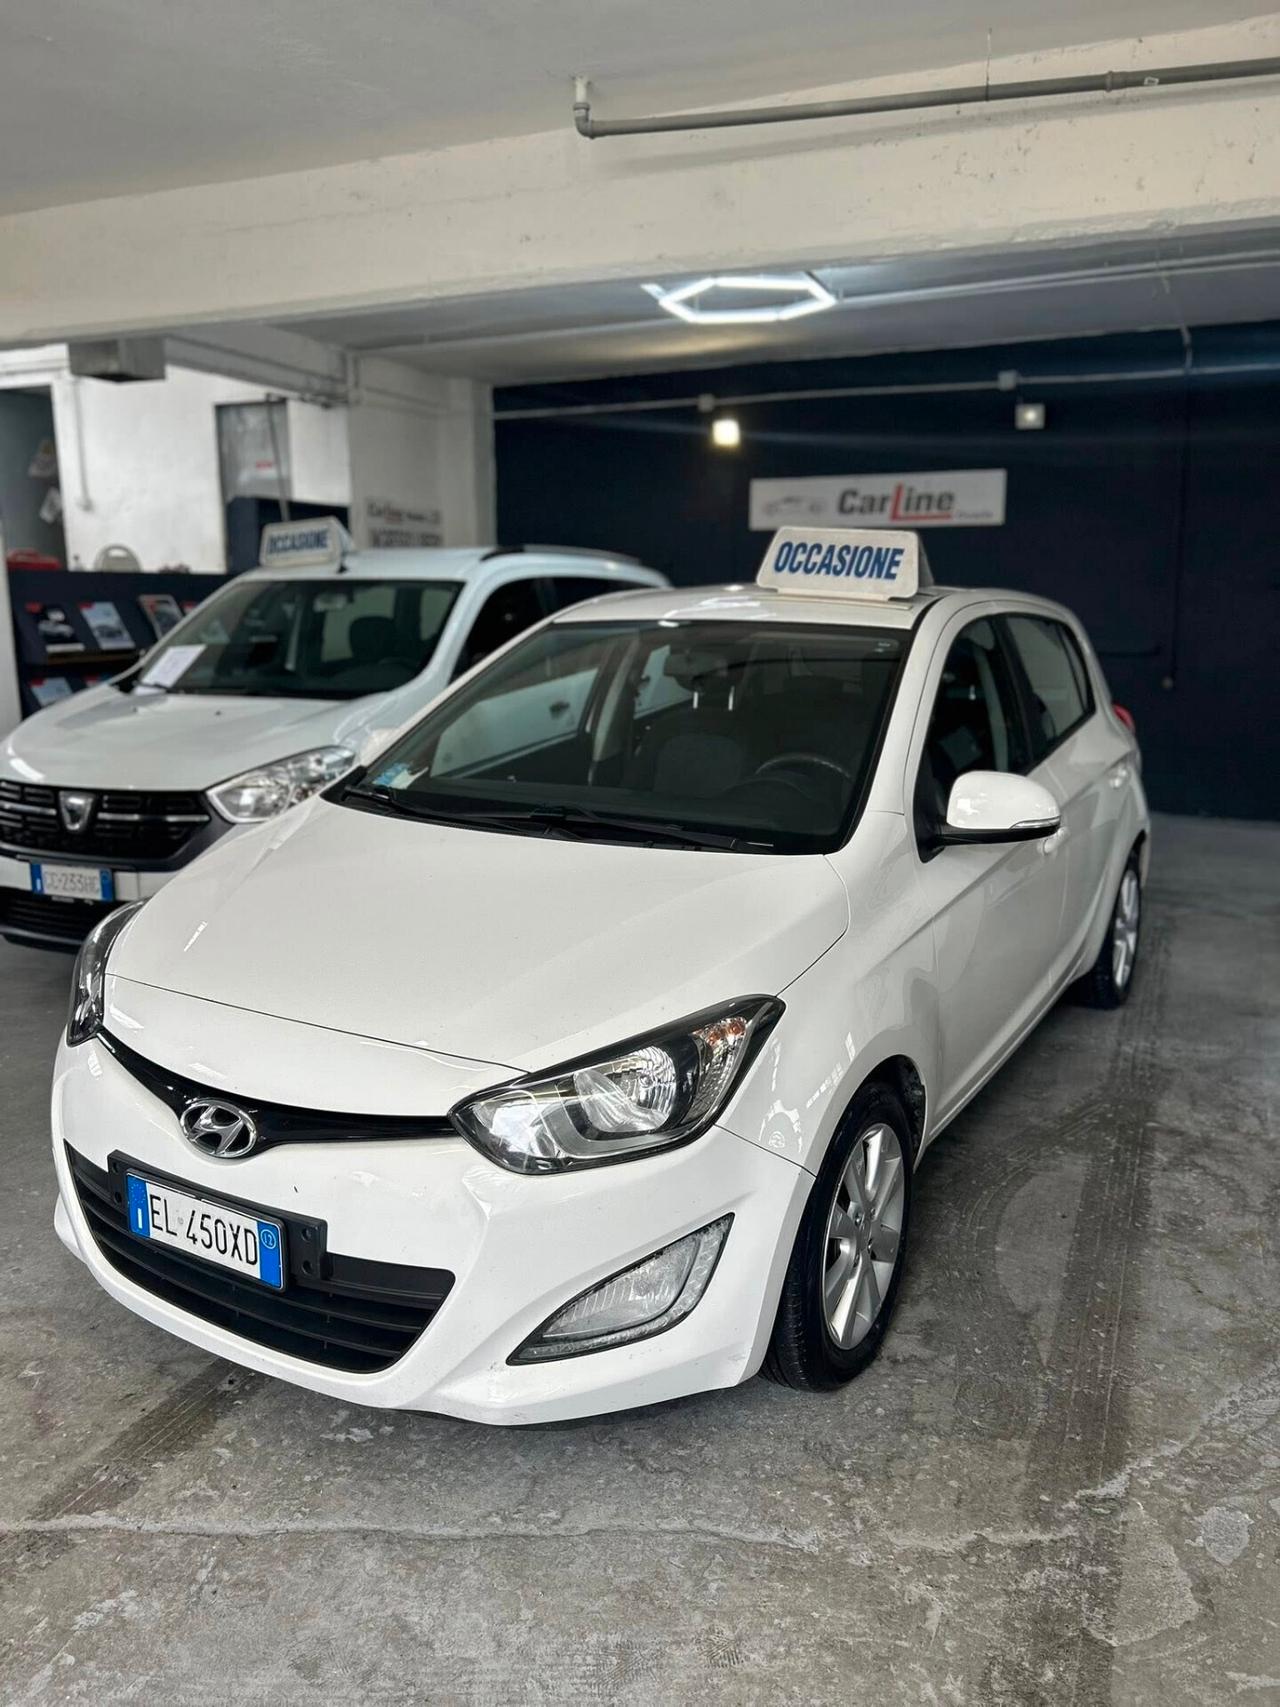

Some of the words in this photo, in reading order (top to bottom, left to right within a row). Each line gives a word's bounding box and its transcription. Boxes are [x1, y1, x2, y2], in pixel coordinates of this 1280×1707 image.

[840, 481, 955, 522] CarLine
[774, 541, 905, 580] OCCASIONE
[149, 1194, 178, 1237] EL
[186, 1210, 259, 1266] 450XD
